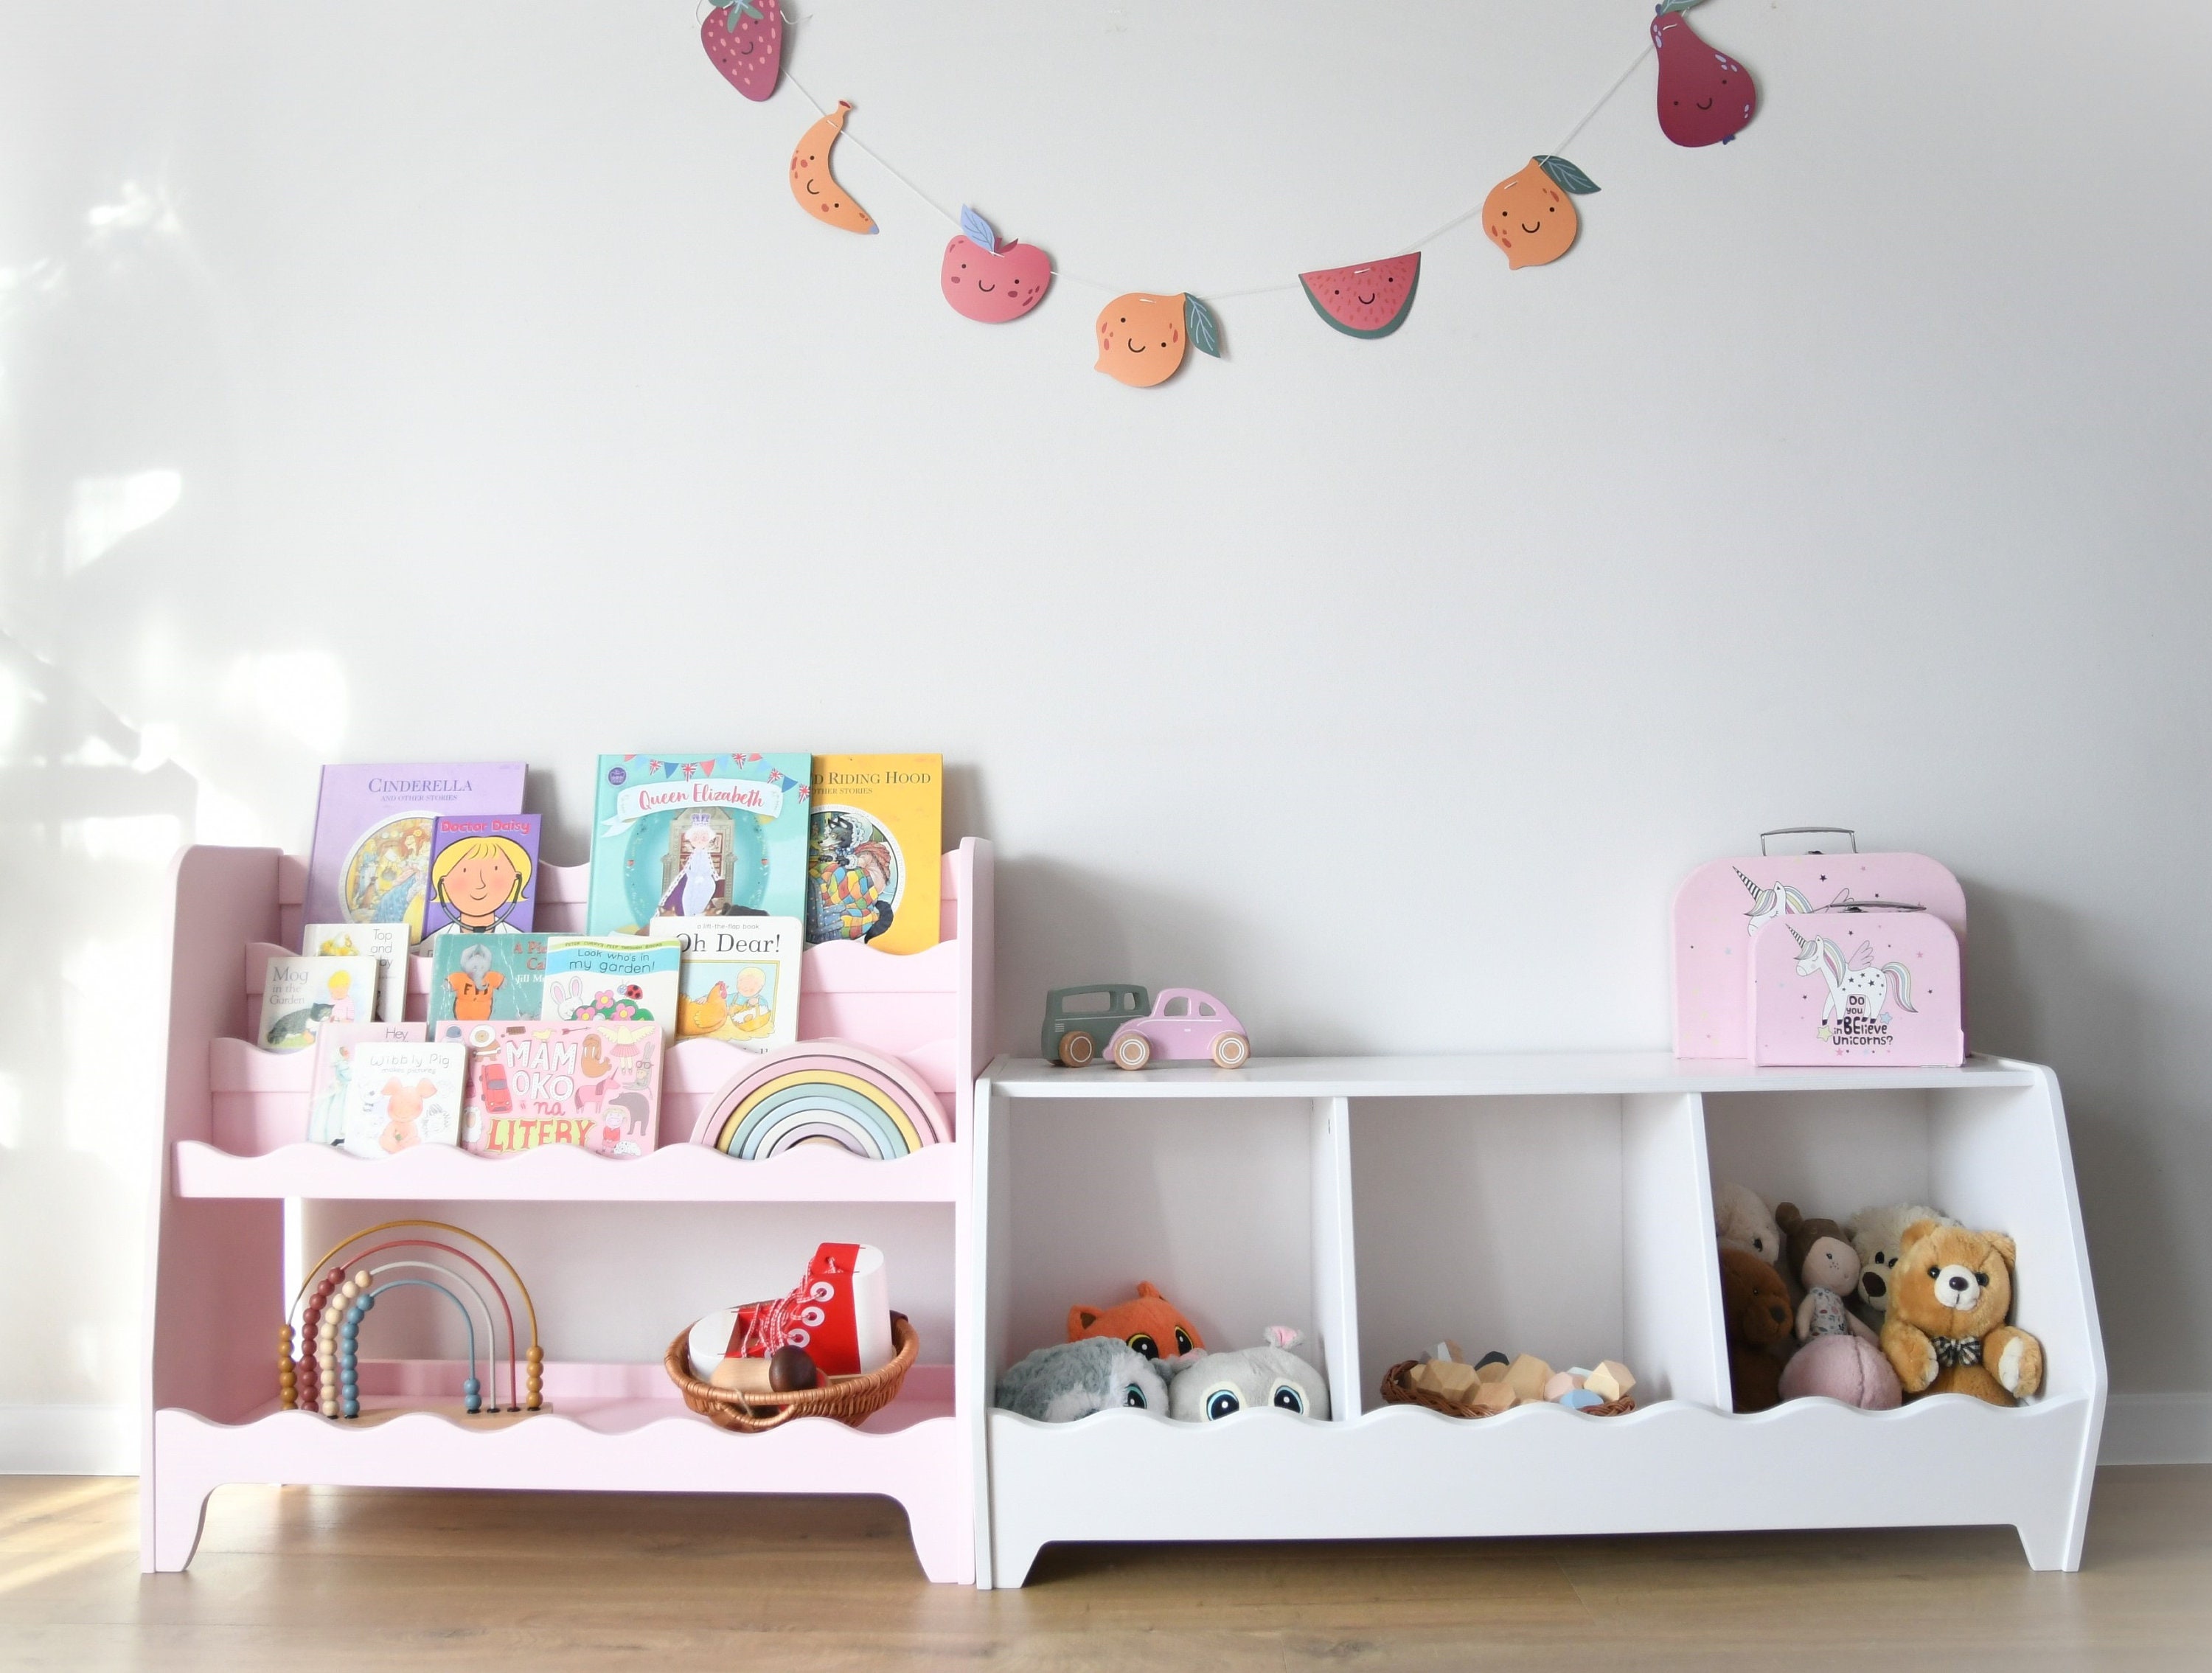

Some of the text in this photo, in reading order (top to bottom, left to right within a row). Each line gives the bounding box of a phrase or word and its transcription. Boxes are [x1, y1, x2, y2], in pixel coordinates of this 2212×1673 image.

[829, 772, 880, 784] RIDING
[886, 771, 931, 784] HOOD
[369, 778, 473, 793] CINDERELLA
[639, 783, 764, 810] Queen Elizabeth
[441, 818, 530, 835] Doctor Daisy
[373, 928, 392, 942] Top
[371, 942, 393, 954] and
[514, 942, 524, 954] A
[716, 933, 780, 953] Dear!
[578, 949, 650, 962] Look who's in
[569, 960, 655, 974] my garden!
[273, 966, 309, 985] Mog
[515, 974, 530, 984] Jill
[286, 983, 302, 992] the
[270, 995, 305, 1004] Garden
[1849, 995, 1865, 1006] Do
[386, 1027, 408, 1040] Hey
[1833, 1035, 1893, 1046] Unicorns?
[370, 1053, 450, 1068] Wibbly Pig
[505, 1040, 578, 1075] MAM
[512, 1070, 574, 1102] OKO
[533, 1102, 566, 1116] na
[484, 1119, 596, 1152] LITERY
